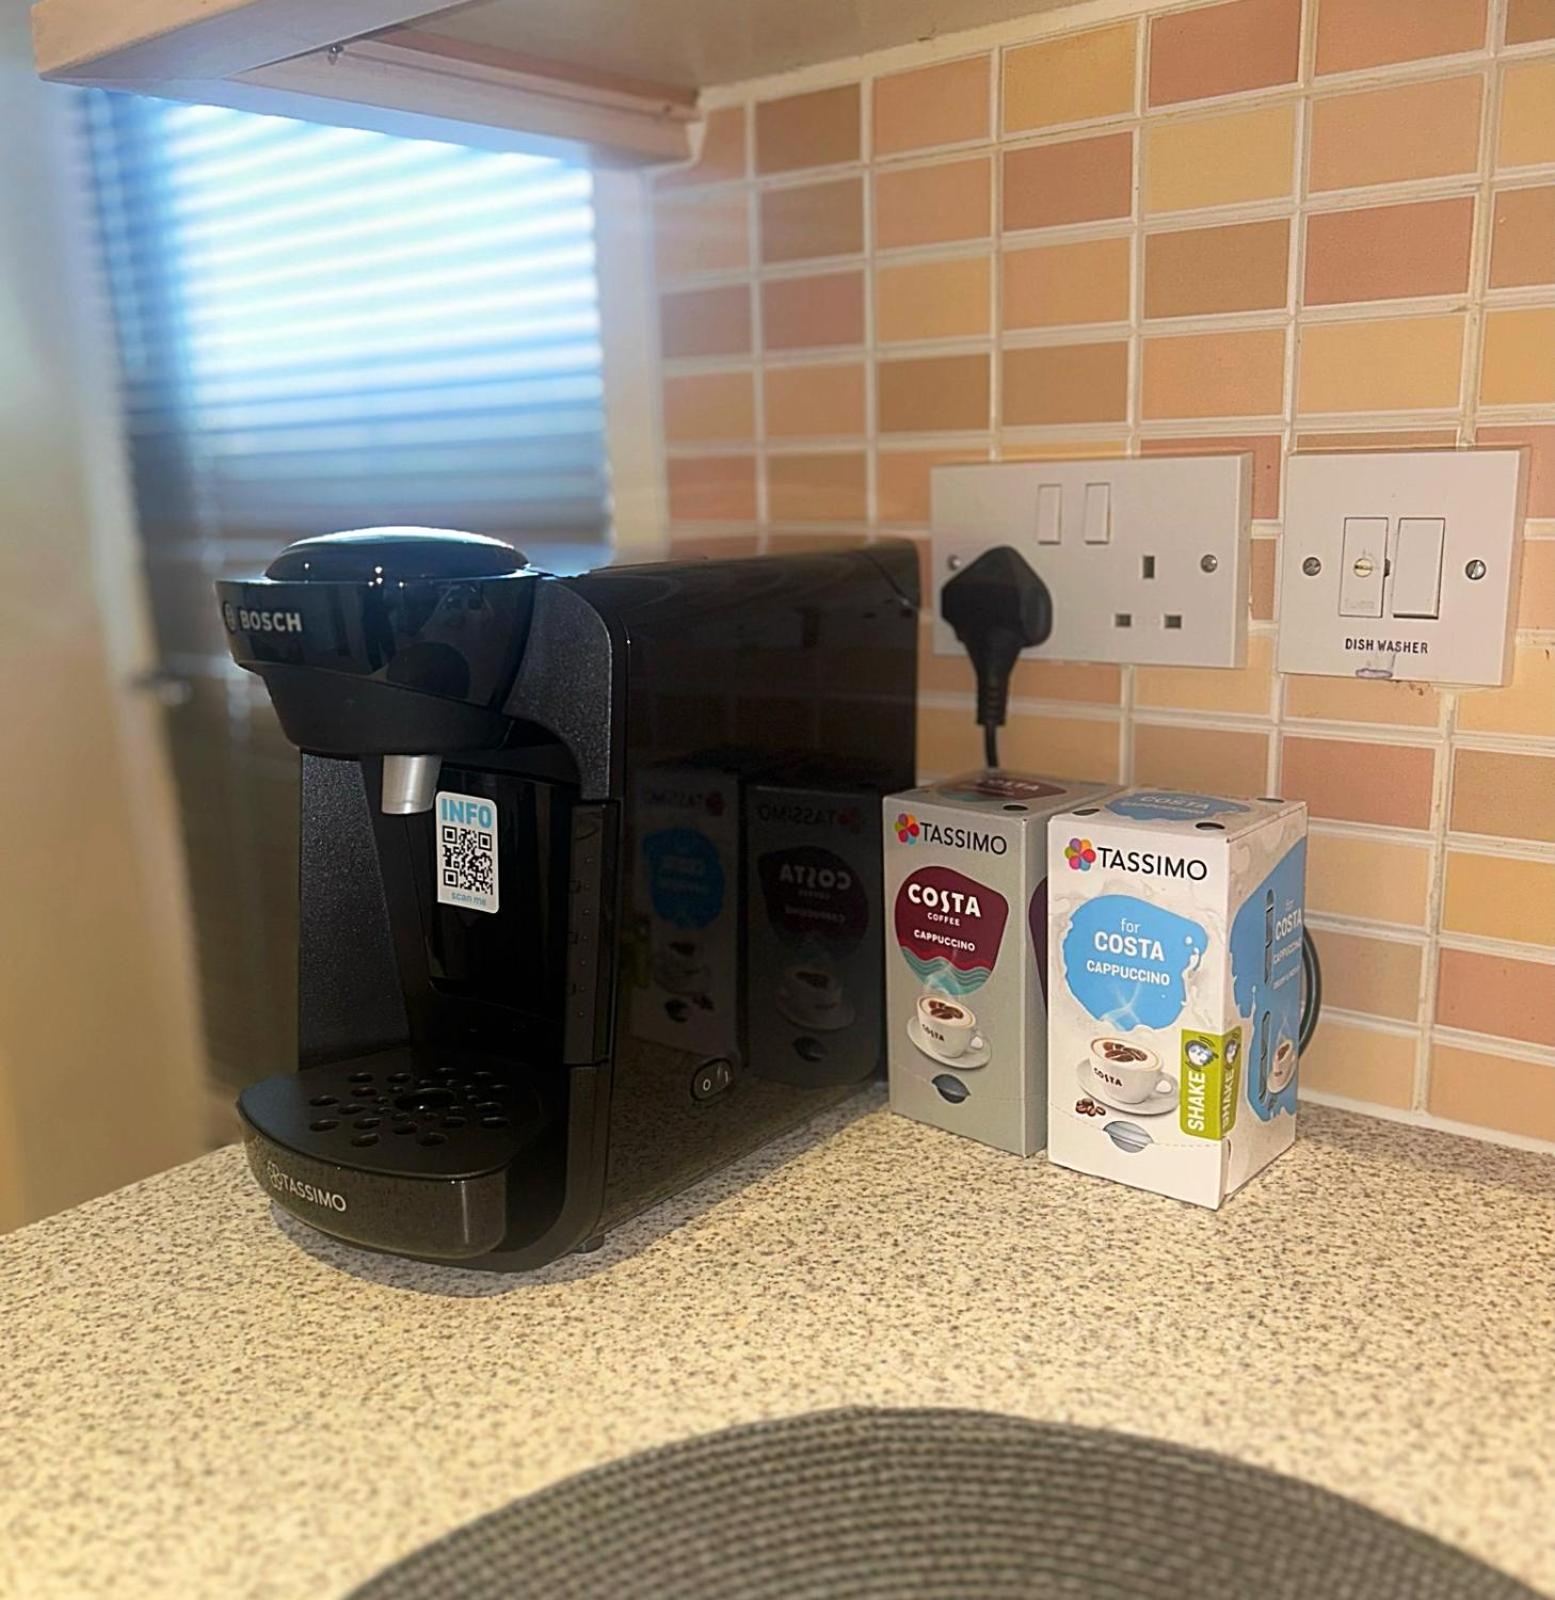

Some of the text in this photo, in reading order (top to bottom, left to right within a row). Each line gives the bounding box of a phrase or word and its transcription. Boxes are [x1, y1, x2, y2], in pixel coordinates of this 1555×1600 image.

[240, 608, 303, 632] BOSCH
[1345, 637, 1429, 655] DISH WASHER
[441, 798, 493, 829] INFO
[919, 821, 1008, 856] TASSIMO
[1097, 846, 1208, 881] TASSIMO
[451, 891, 473, 903] scan
[907, 883, 982, 918] COSTA
[926, 911, 961, 927] COFFEE
[1120, 917, 1142, 934] for
[1275, 907, 1302, 941] COSTA
[913, 928, 976, 952] CAPPUCCINO
[1093, 930, 1166, 963] COSTA
[1085, 959, 1171, 986] CAPPUCCINO
[921, 1023, 945, 1042] COSTA
[1093, 1066, 1123, 1087] COSTA
[1187, 1070, 1206, 1132] SHAKE
[1222, 1068, 1235, 1130] SHAKE
[281, 1174, 347, 1212] TASSIMO
